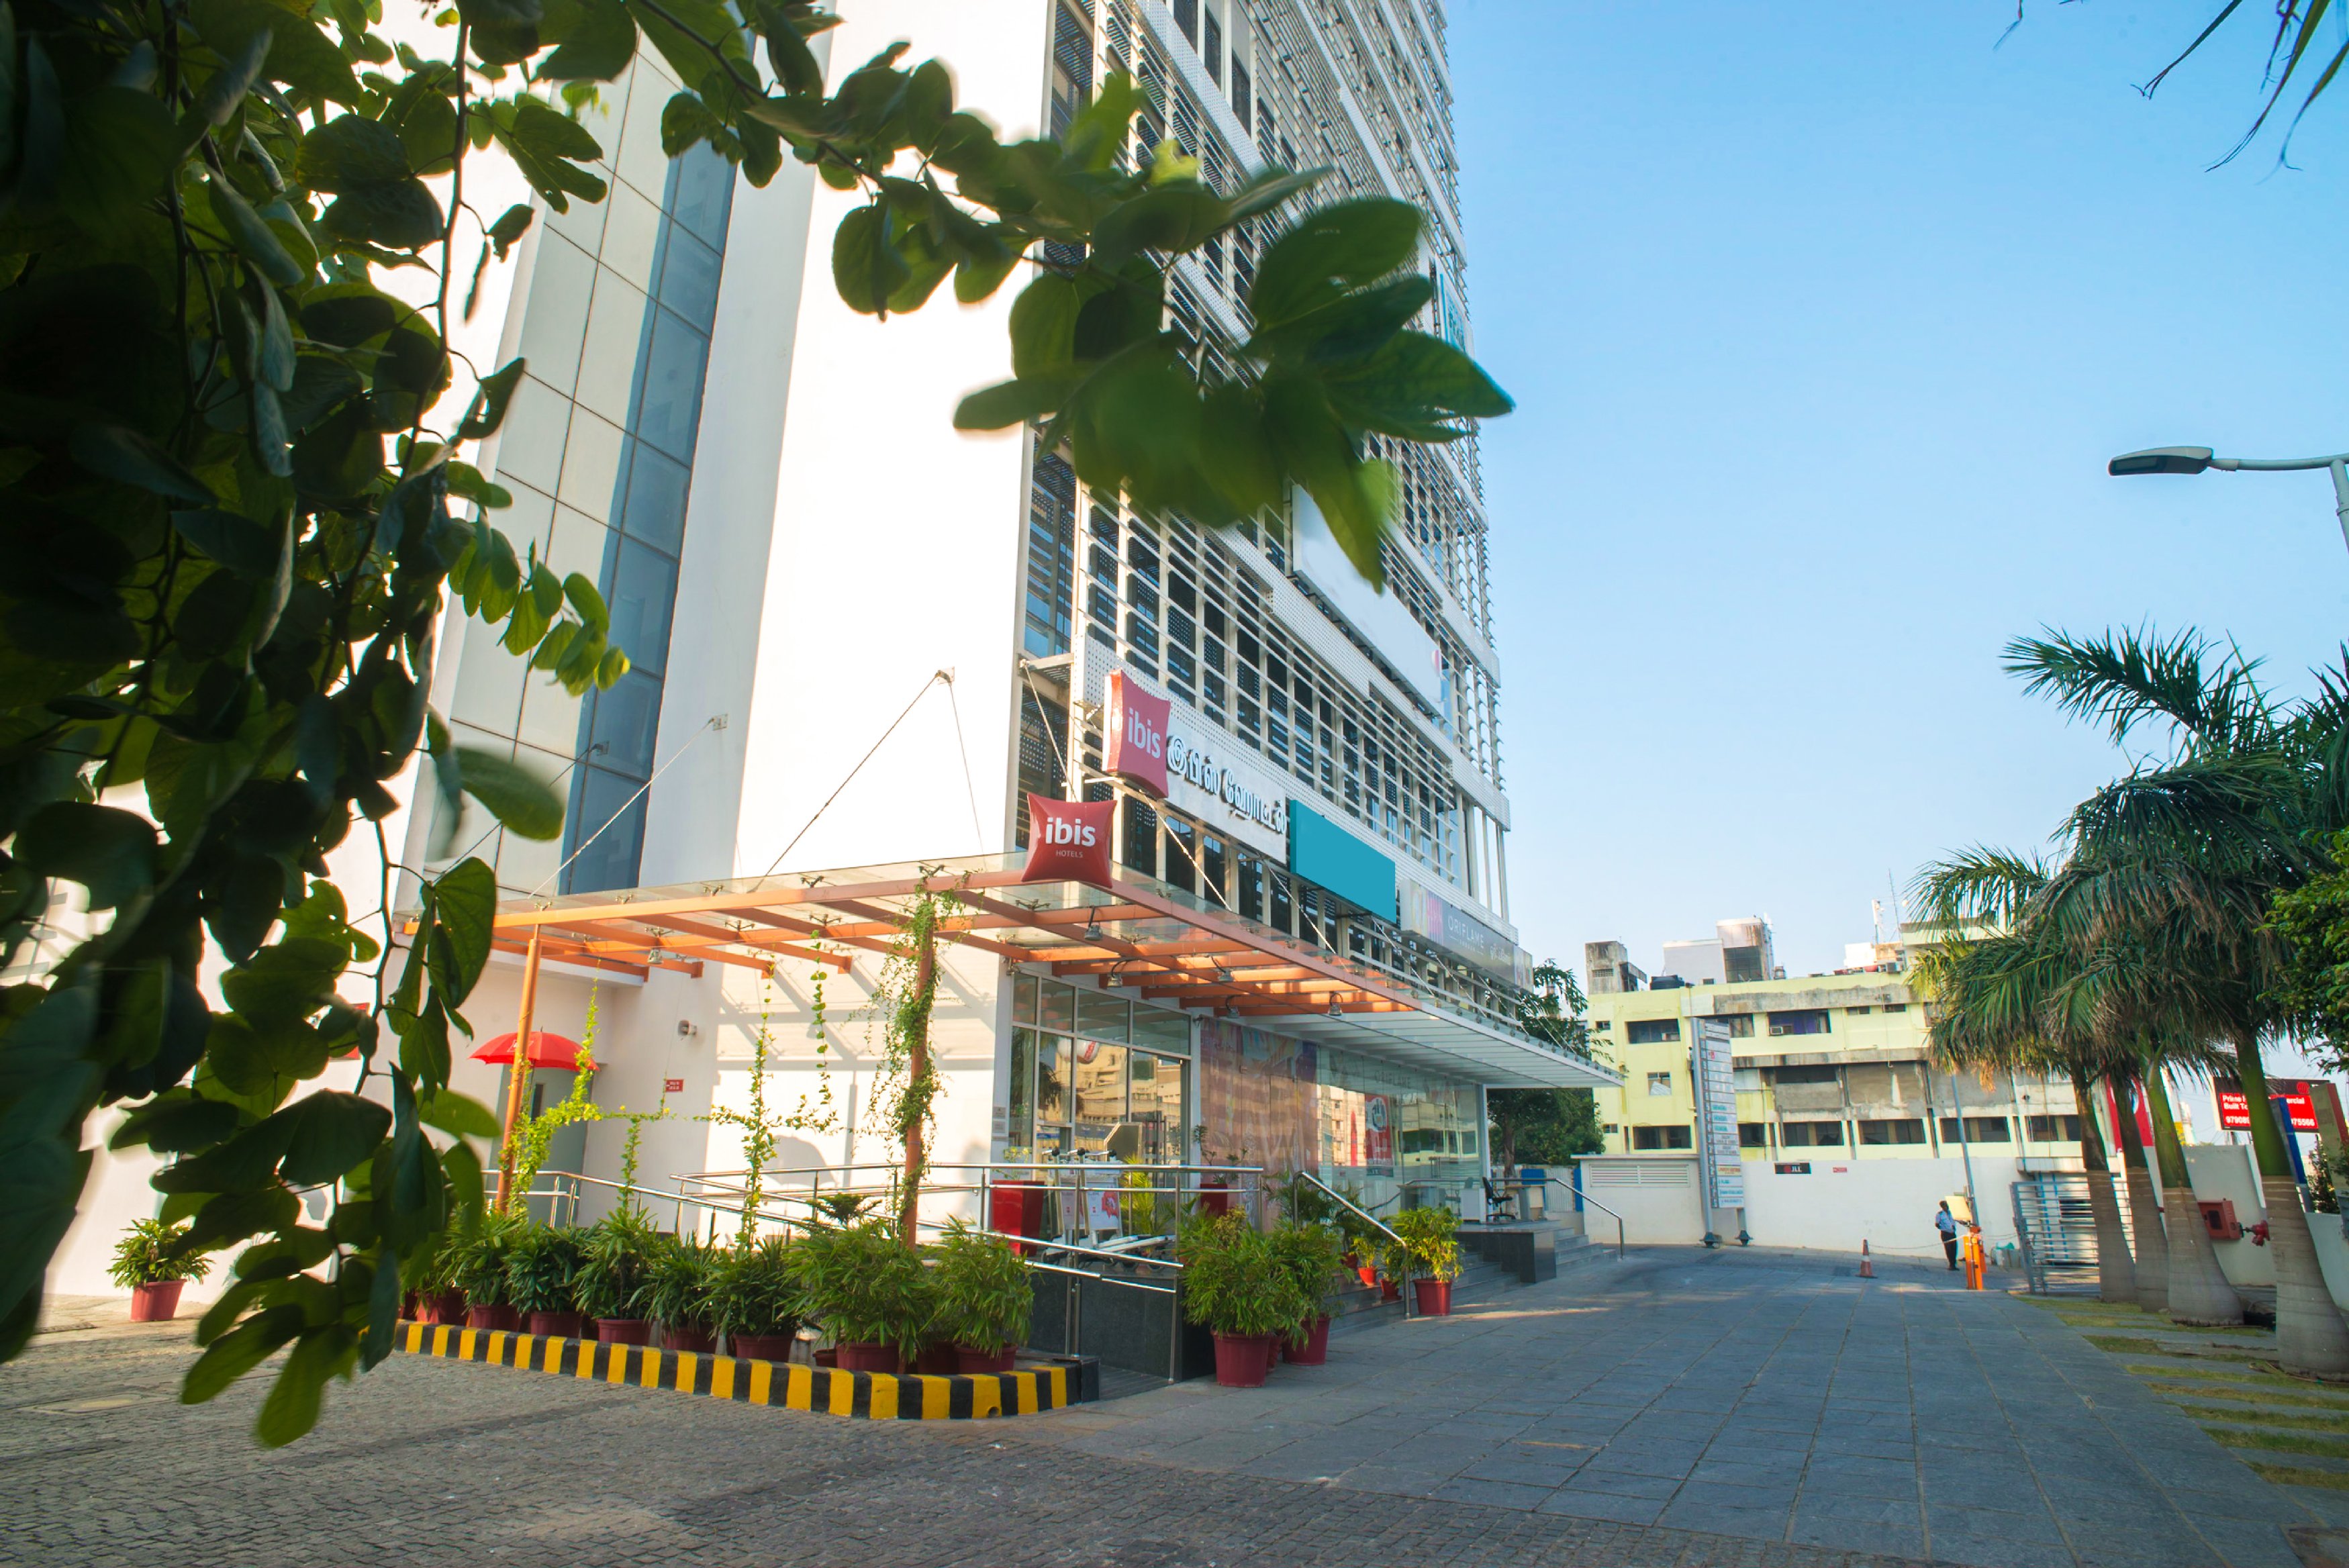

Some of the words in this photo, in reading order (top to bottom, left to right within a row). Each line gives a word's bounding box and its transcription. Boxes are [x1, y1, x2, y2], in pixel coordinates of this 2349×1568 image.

[1129, 707, 1161, 758] ibis
[1167, 735, 1220, 795] இபிஸ்
[1045, 817, 1096, 846] ibis
[1055, 850, 1084, 859] HOTELS
[1447, 915, 1484, 949] ORIFLAME
